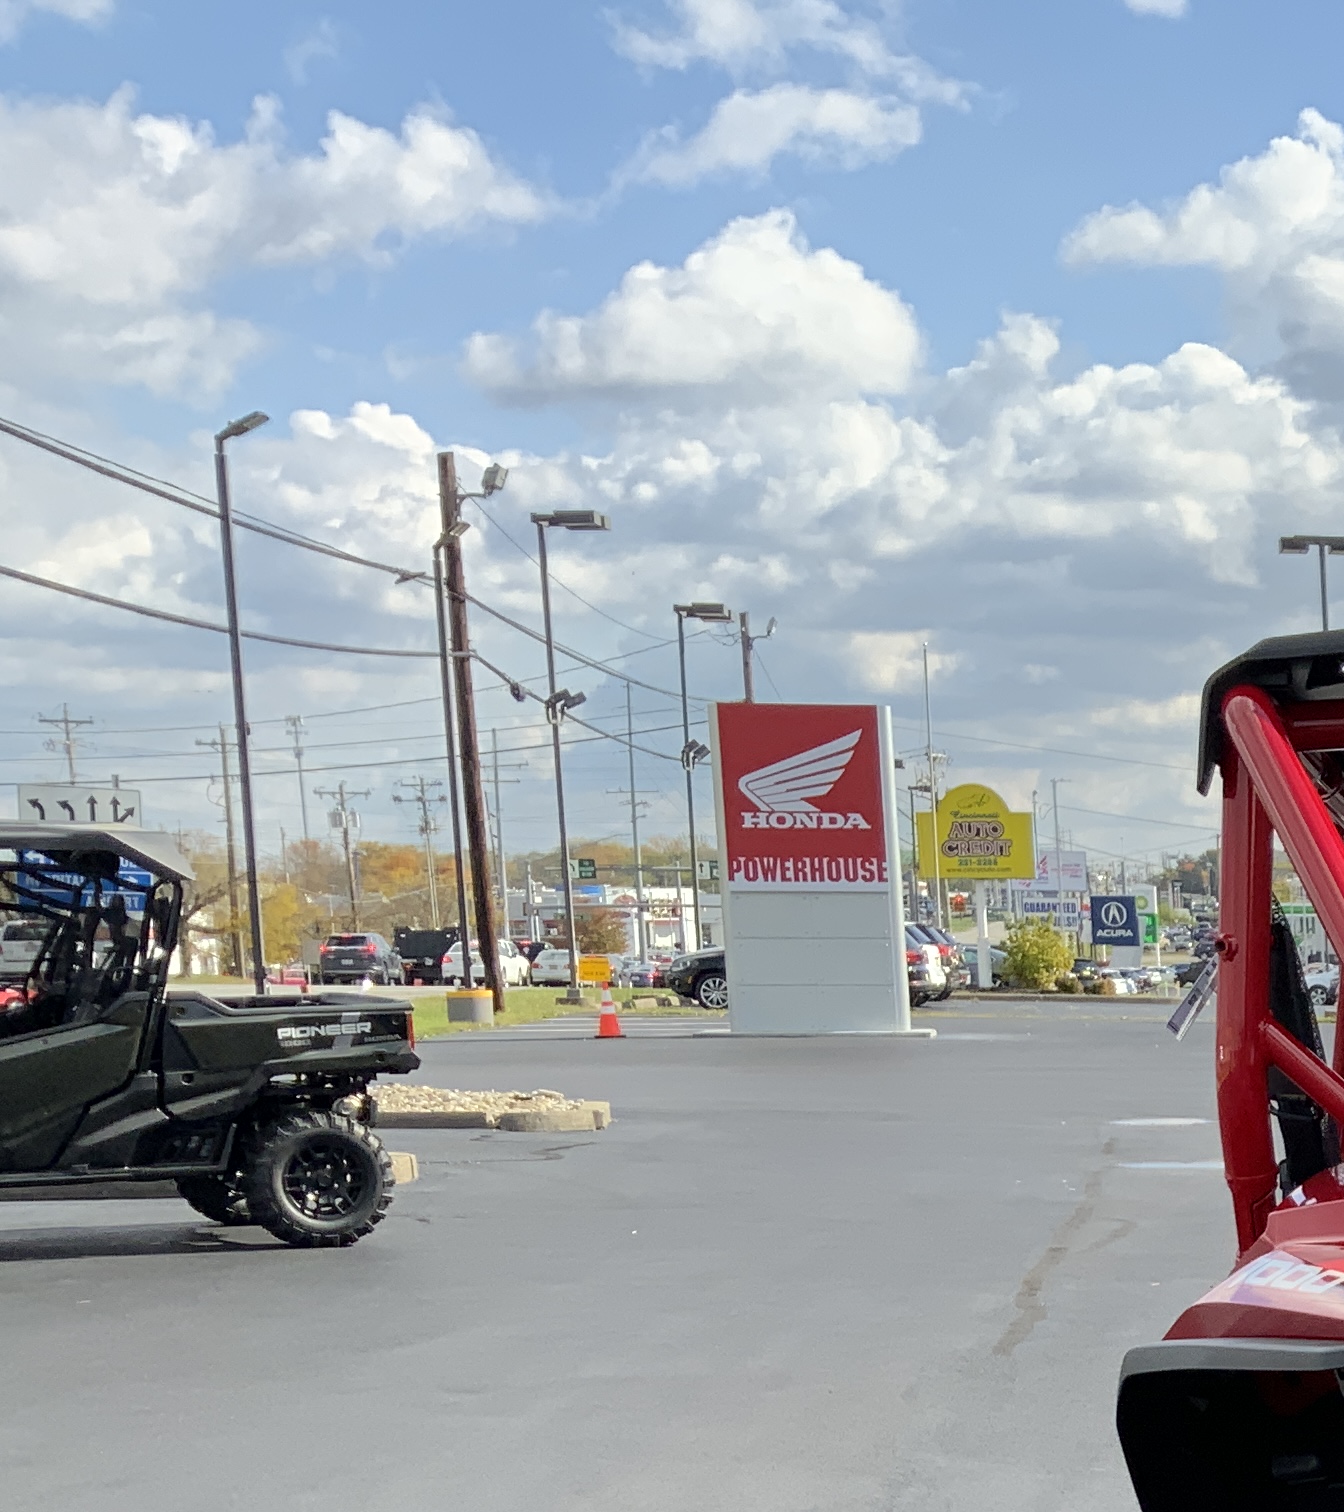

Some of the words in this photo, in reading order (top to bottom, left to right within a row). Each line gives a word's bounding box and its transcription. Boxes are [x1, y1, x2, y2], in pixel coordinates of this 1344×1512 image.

[741, 812, 872, 829] HONDA
[948, 821, 1004, 839] AUTO
[941, 839, 1013, 857] CREDIT
[728, 856, 889, 883] POWERHOUSE
[1096, 929, 1134, 938] ACURA
[277, 1022, 372, 1040] PIONEER
